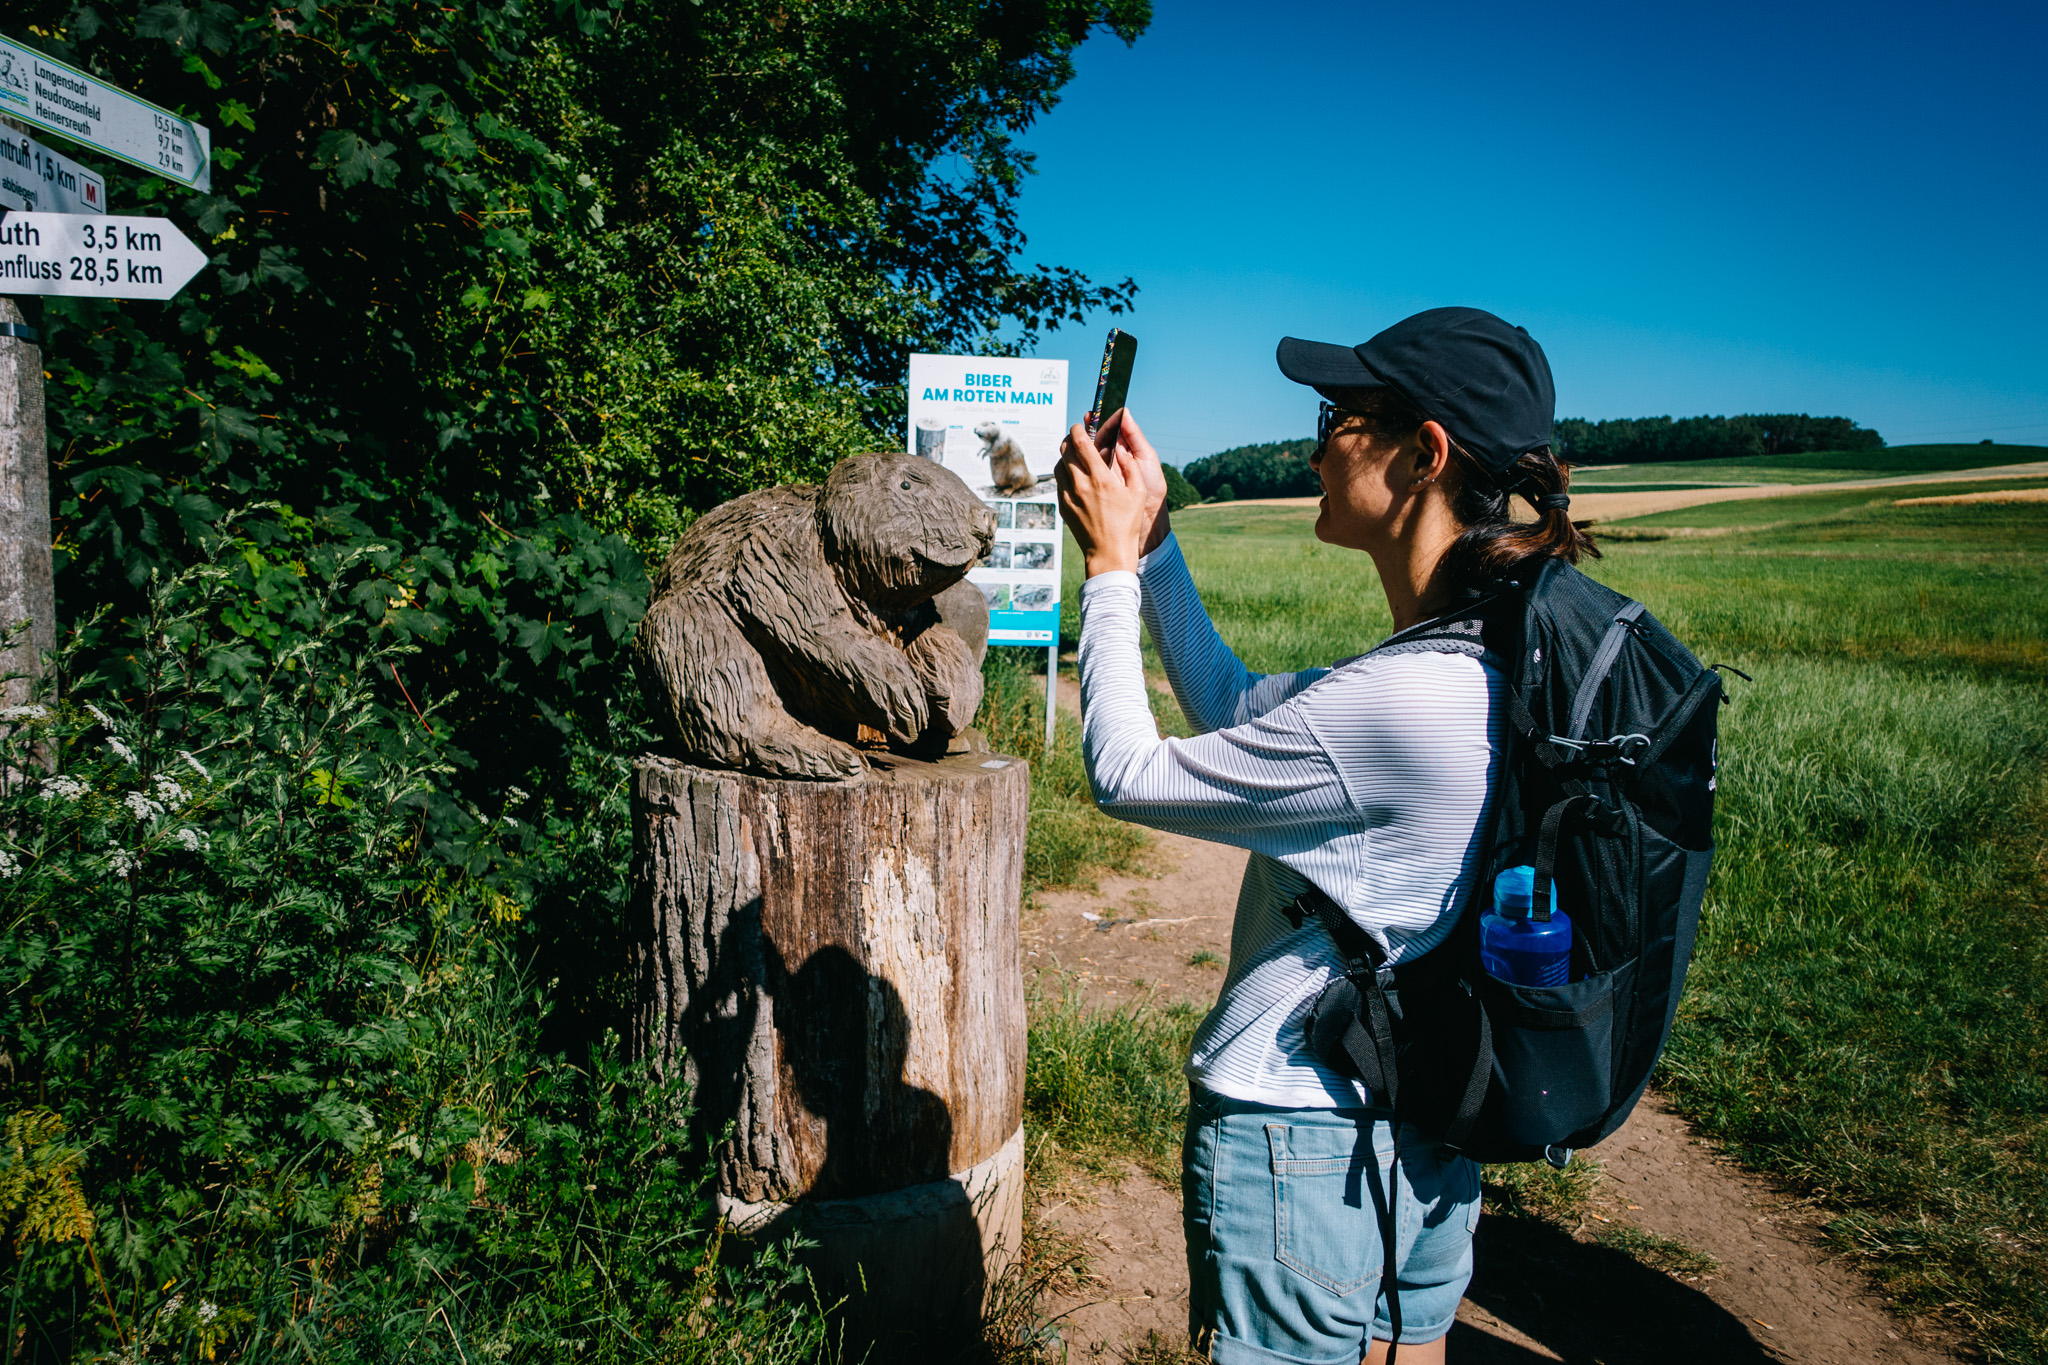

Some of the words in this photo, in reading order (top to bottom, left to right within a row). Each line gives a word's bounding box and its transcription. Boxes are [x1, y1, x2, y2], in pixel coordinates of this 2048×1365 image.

[34, 60, 88, 97] Langenstadt
[34, 81, 101, 121] Neudrossenfeld
[35, 100, 91, 136] Heinersreuth
[153, 114, 170, 133] 15,5
[171, 122, 183, 138] km
[158, 134, 170, 151] 9,7
[171, 140, 183, 156] km
[34, 151, 54, 182] 1,5
[57, 161, 76, 193] km
[158, 152, 170, 168] 2,9
[171, 156, 183, 173] km
[86, 183, 97, 204] M
[82, 224, 118, 253] 3,5
[125, 226, 161, 251] km
[69, 256, 119, 286] 28,5
[127, 259, 163, 284] km
[965, 373, 1012, 388] BIBER
[922, 388, 949, 401] AM
[953, 389, 1006, 404] ROTEN
[1010, 391, 1053, 405] MAIN
